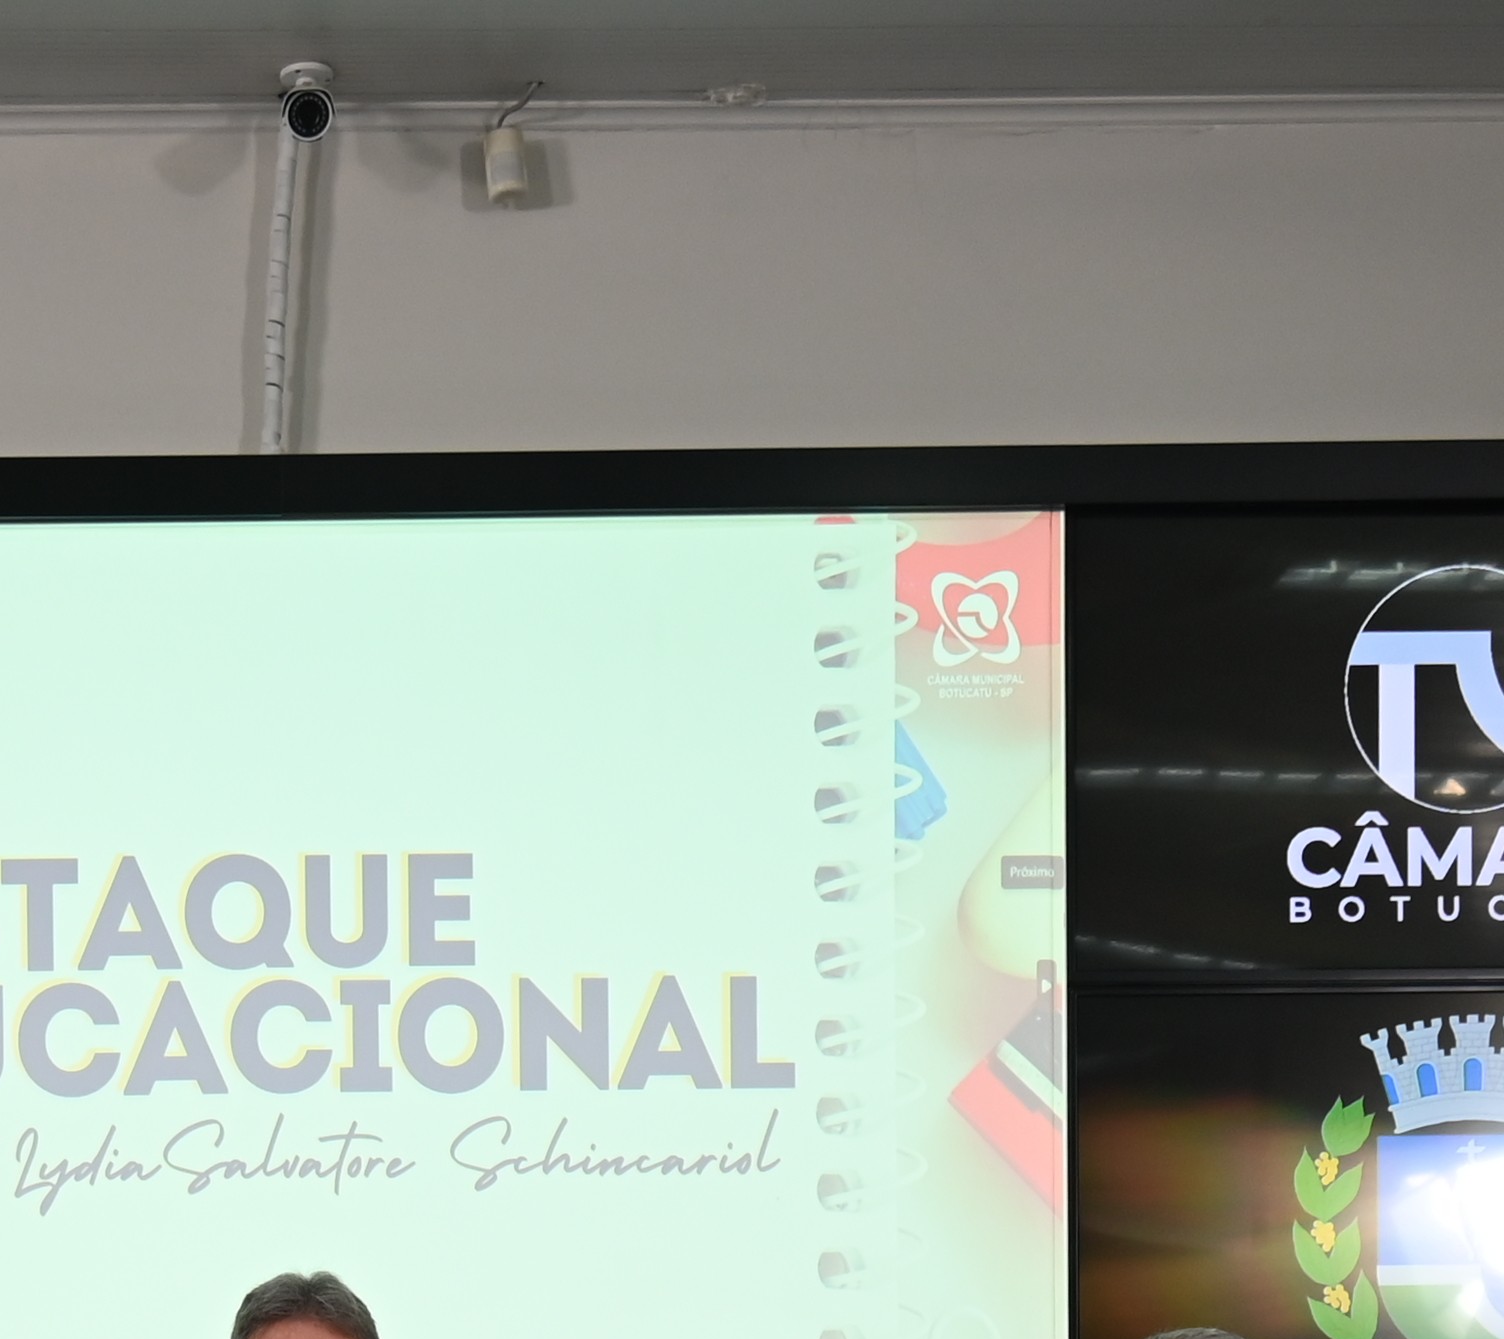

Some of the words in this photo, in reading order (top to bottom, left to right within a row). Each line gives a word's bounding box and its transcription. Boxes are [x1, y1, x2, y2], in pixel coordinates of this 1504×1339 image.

[1010, 866, 1055, 878] Próximo
[14, 1125, 166, 1216] Lydia
[164, 1113, 416, 1196] Salvatore
[450, 1108, 781, 1193] Schincariol
